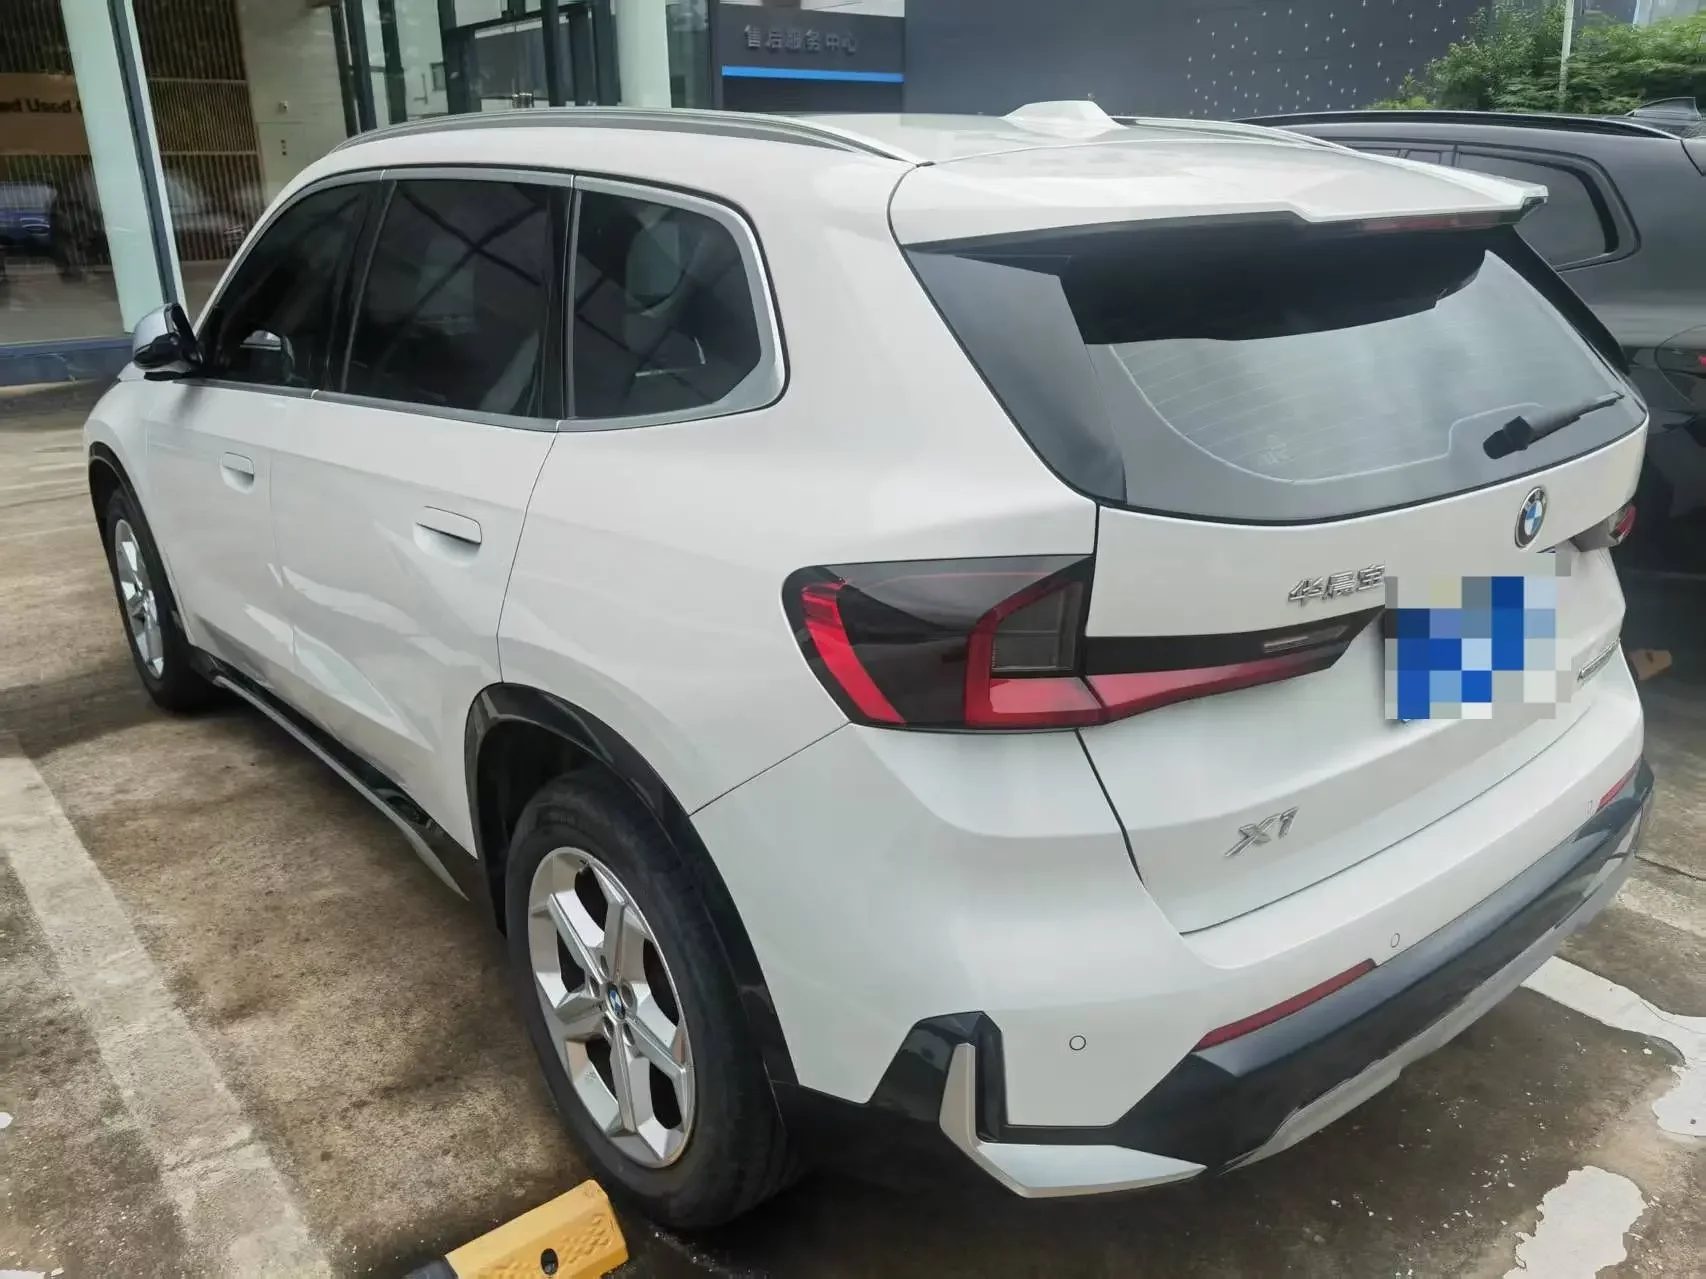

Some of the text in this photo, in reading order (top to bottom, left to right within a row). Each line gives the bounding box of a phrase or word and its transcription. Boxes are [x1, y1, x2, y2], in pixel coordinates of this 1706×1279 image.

[744, 24, 859, 53] 售后服务中心
[1225, 806, 1299, 857] X1
